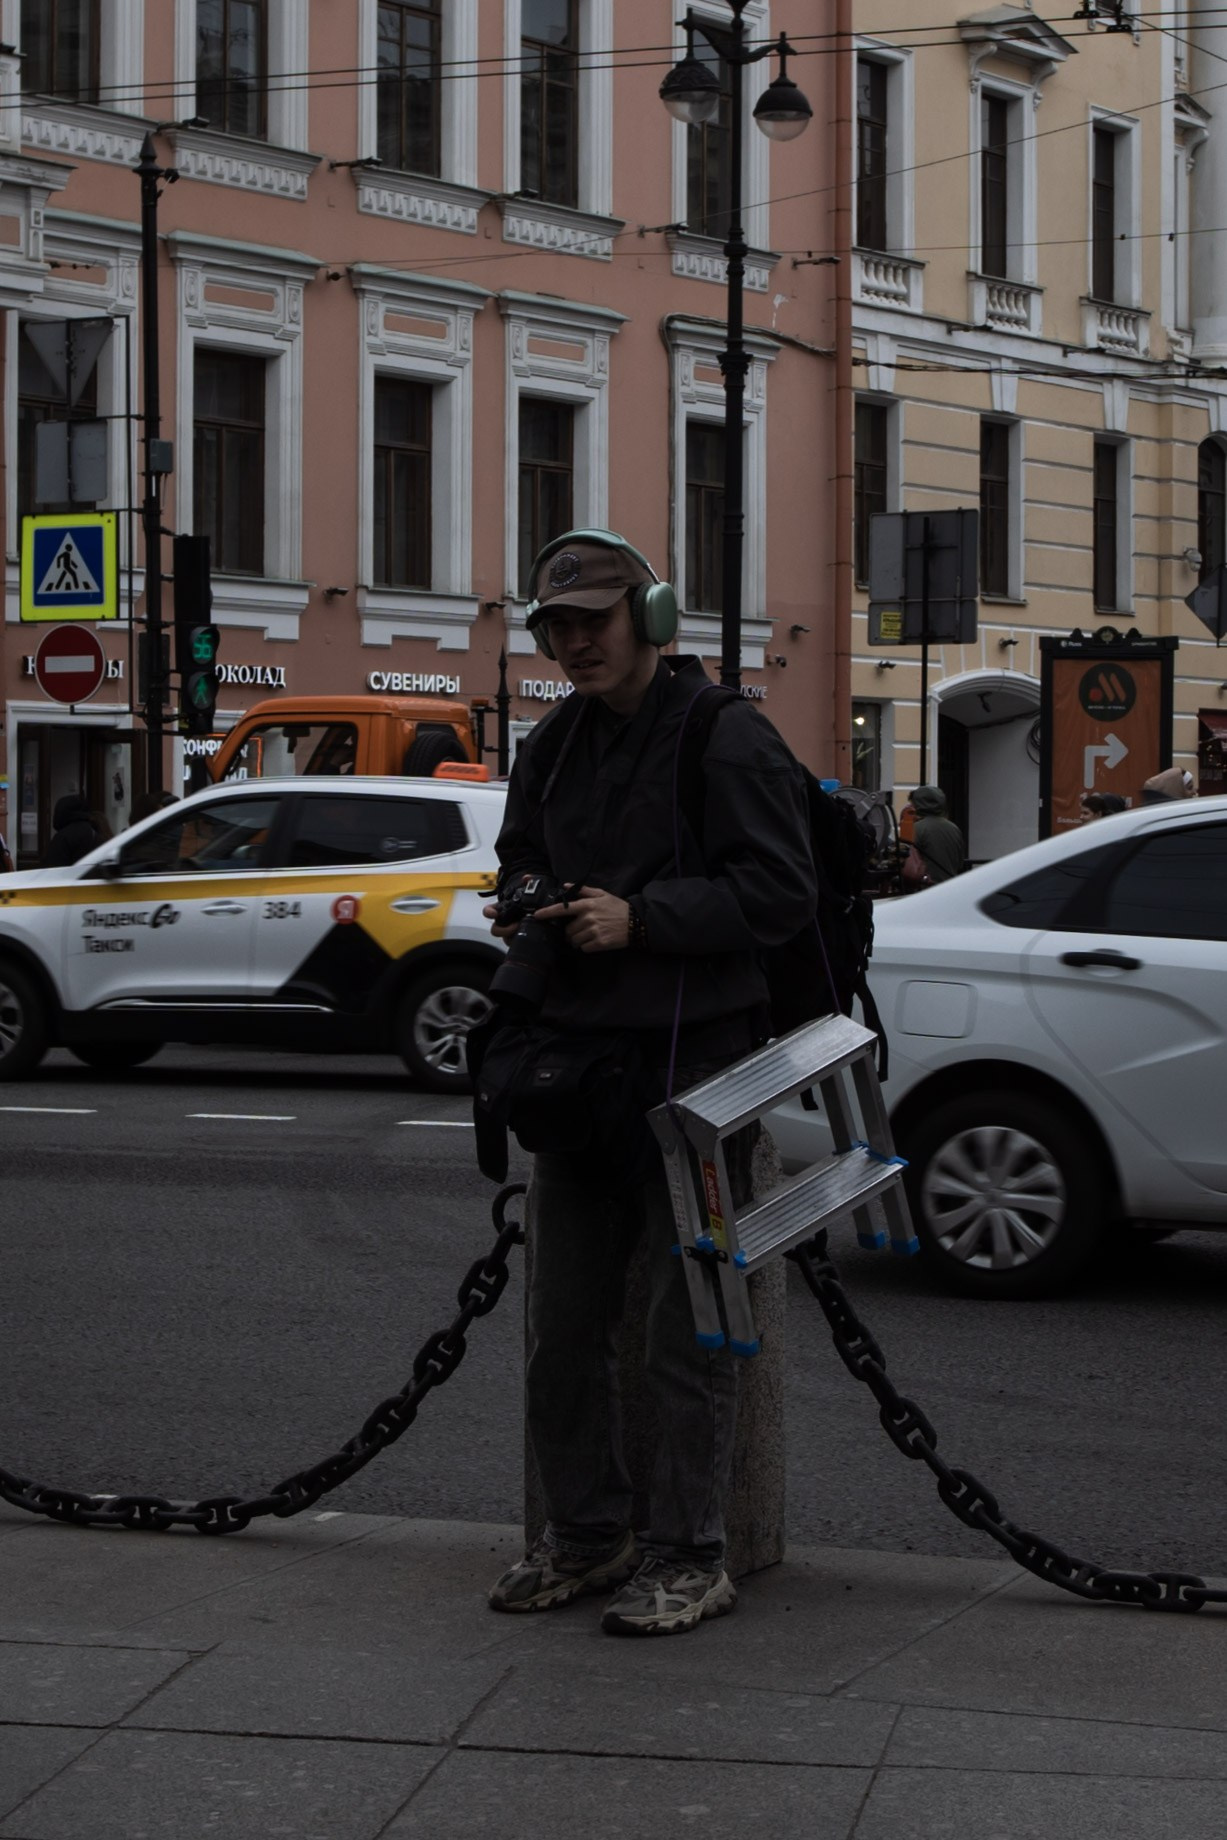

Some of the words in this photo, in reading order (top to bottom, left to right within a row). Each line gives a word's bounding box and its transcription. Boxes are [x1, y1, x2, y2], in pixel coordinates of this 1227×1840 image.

[214, 664, 286, 688] ОКОЛАД
[368, 671, 460, 693] СУВЕНИРЫ
[522, 679, 576, 701] ПОДАР
[82, 909, 150, 929] Яндекс
[262, 901, 301, 919] 384
[82, 935, 135, 953] Такси
